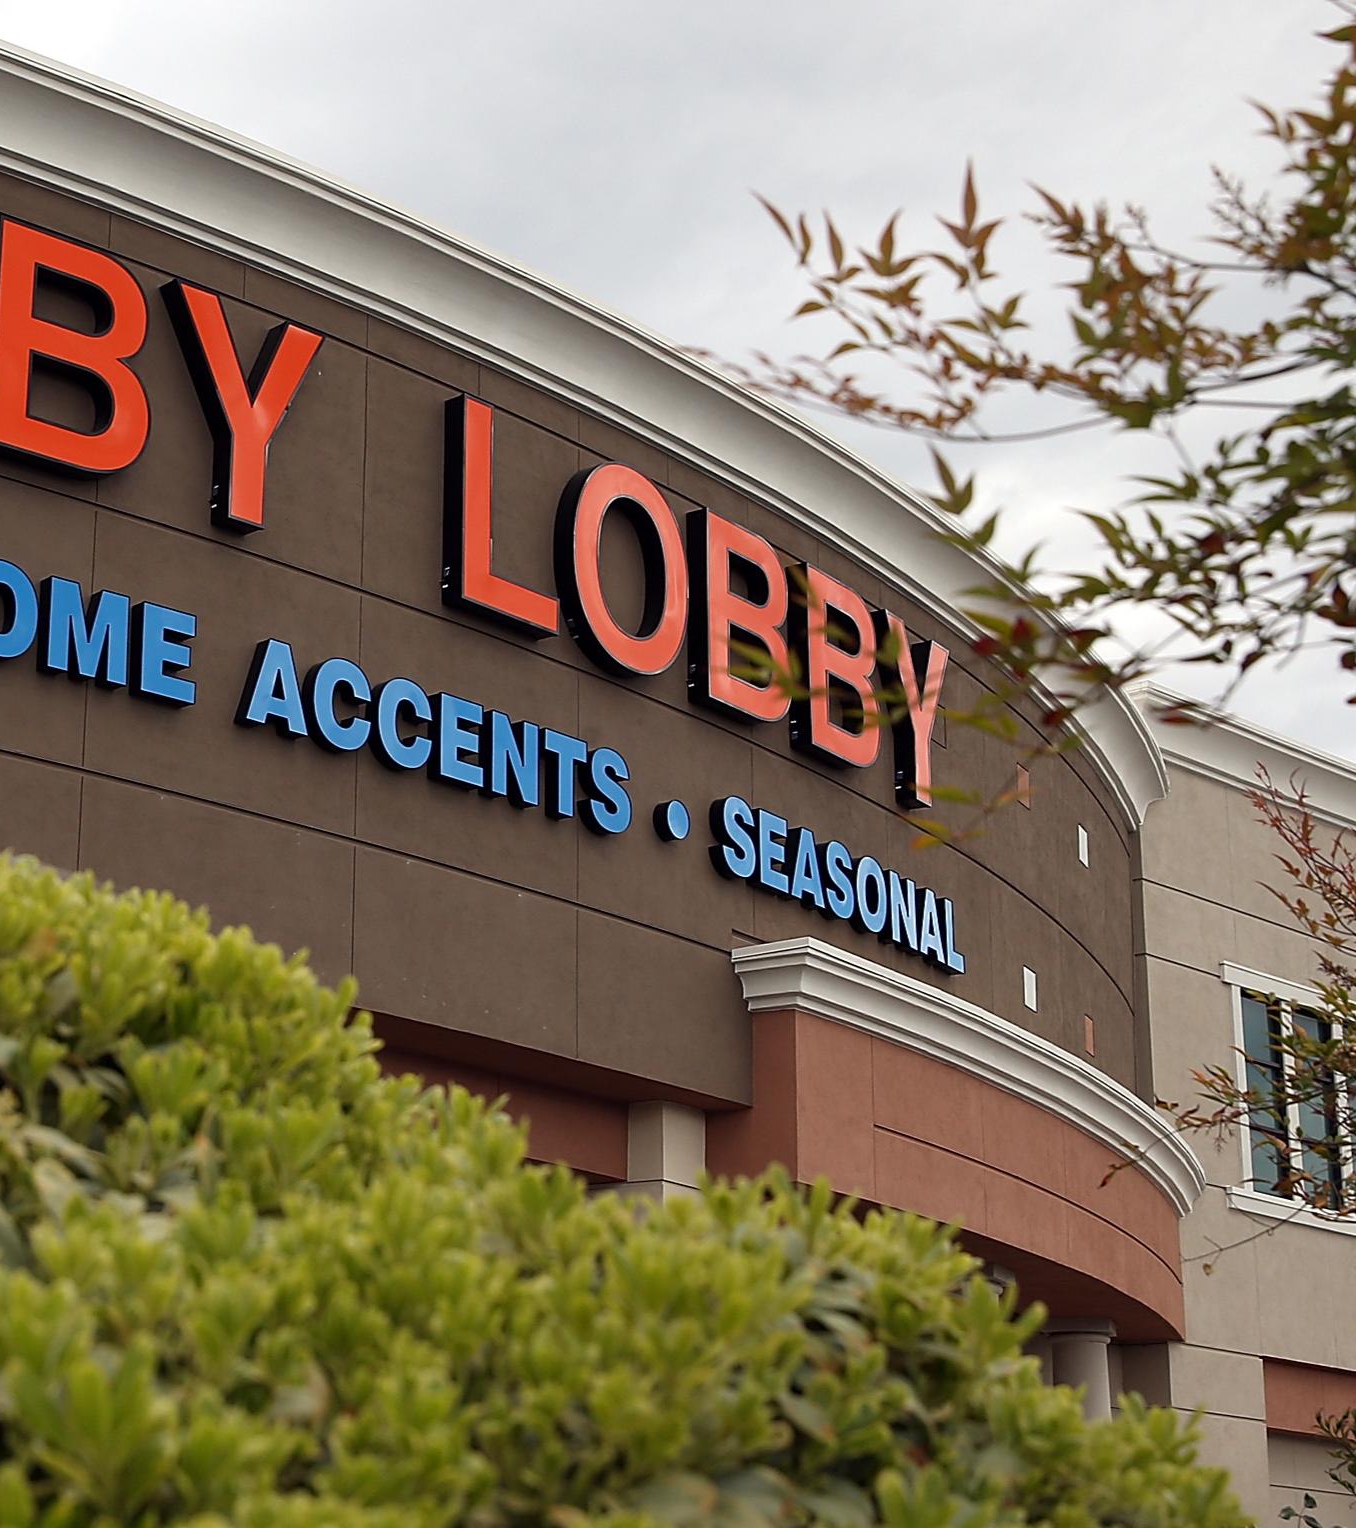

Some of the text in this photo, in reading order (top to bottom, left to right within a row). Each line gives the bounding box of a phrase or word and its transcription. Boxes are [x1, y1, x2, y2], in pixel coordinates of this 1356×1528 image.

[454, 397, 950, 807] LOBBY
[246, 640, 632, 836] ACCENTS
[721, 795, 966, 974] SEASONAL
